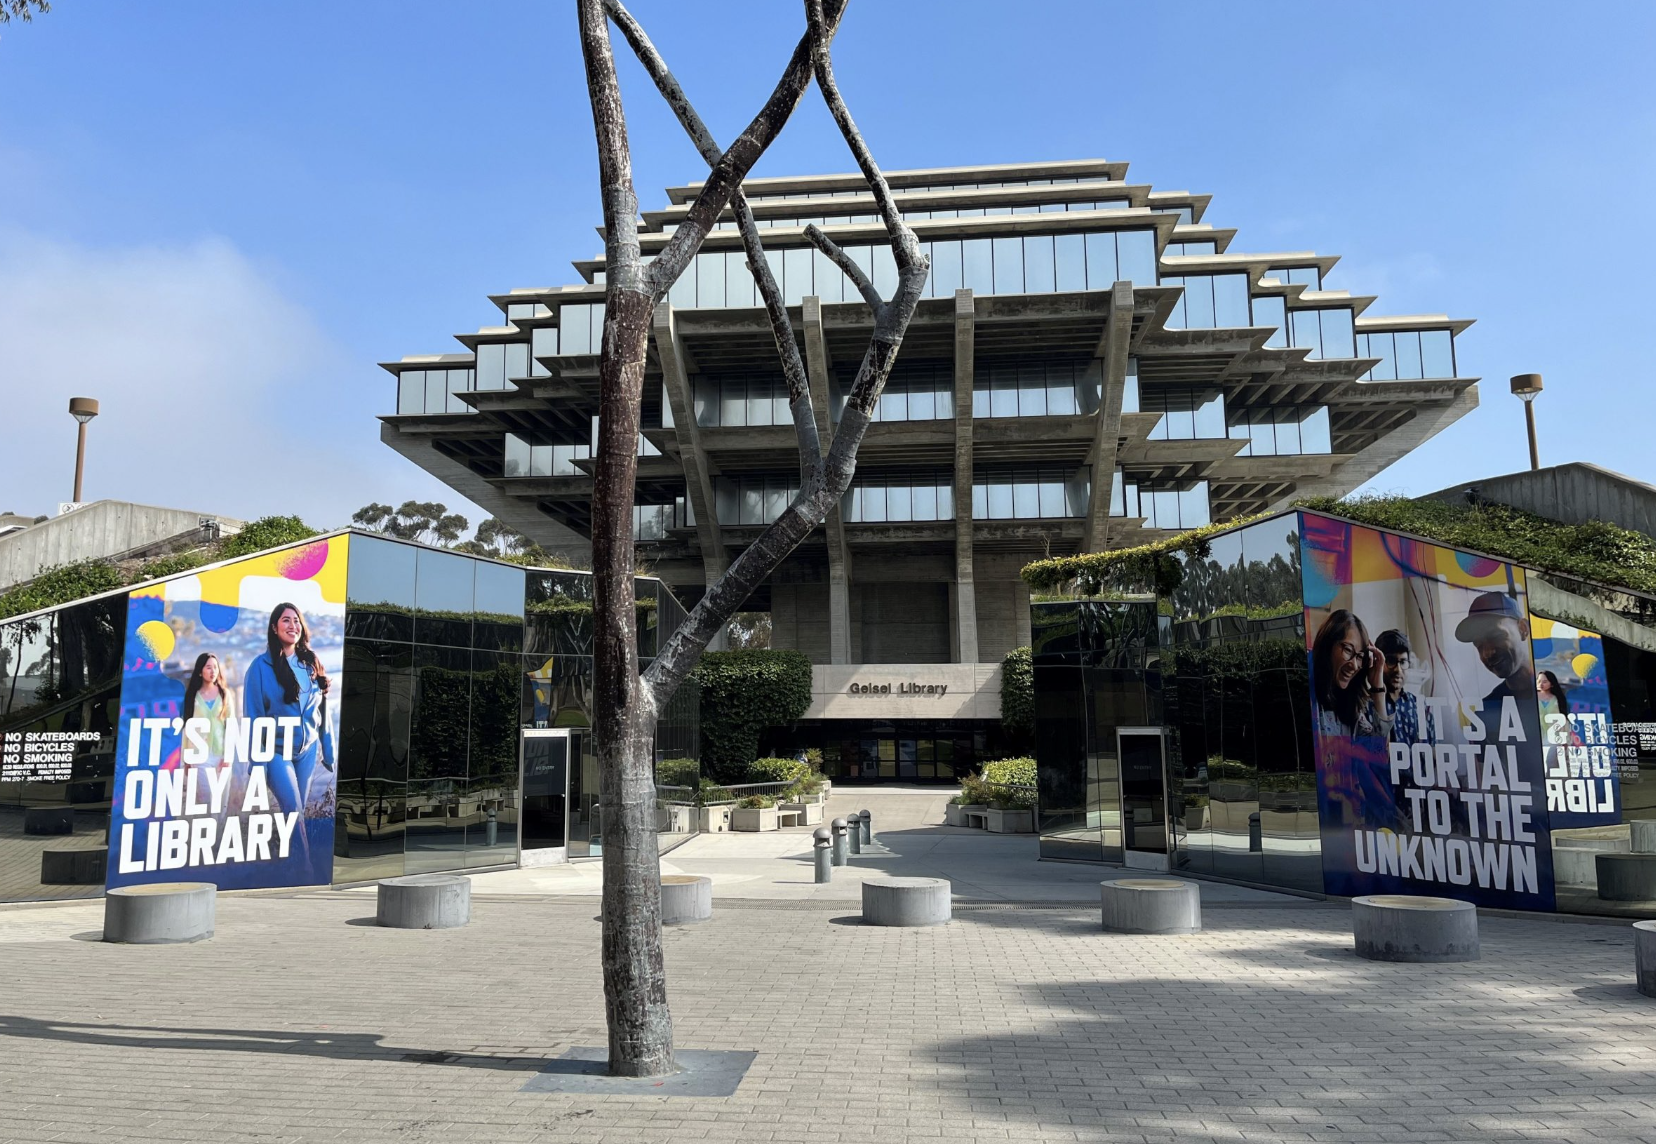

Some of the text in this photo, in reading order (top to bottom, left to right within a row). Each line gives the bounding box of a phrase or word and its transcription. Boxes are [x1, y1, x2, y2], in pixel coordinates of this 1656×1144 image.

[849, 682, 948, 696] Geisel Library
[5, 732, 101, 741] NO SKATEBOARDS
[127, 716, 301, 767] IT'S NOT
[1499, 696, 1527, 742] A
[1586, 735, 1637, 745] BICYCLES
[3, 753, 73, 763] NO SMOKING
[4, 742, 75, 752] NO BICYCLES
[1389, 742, 1532, 792] PORTAL
[1587, 747, 1637, 757] SMOKING
[123, 765, 270, 820] ONLY A
[1404, 788, 1536, 843] TO THE
[118, 811, 299, 874] LIBRARY
[1354, 829, 1539, 894] UNKNOWN
